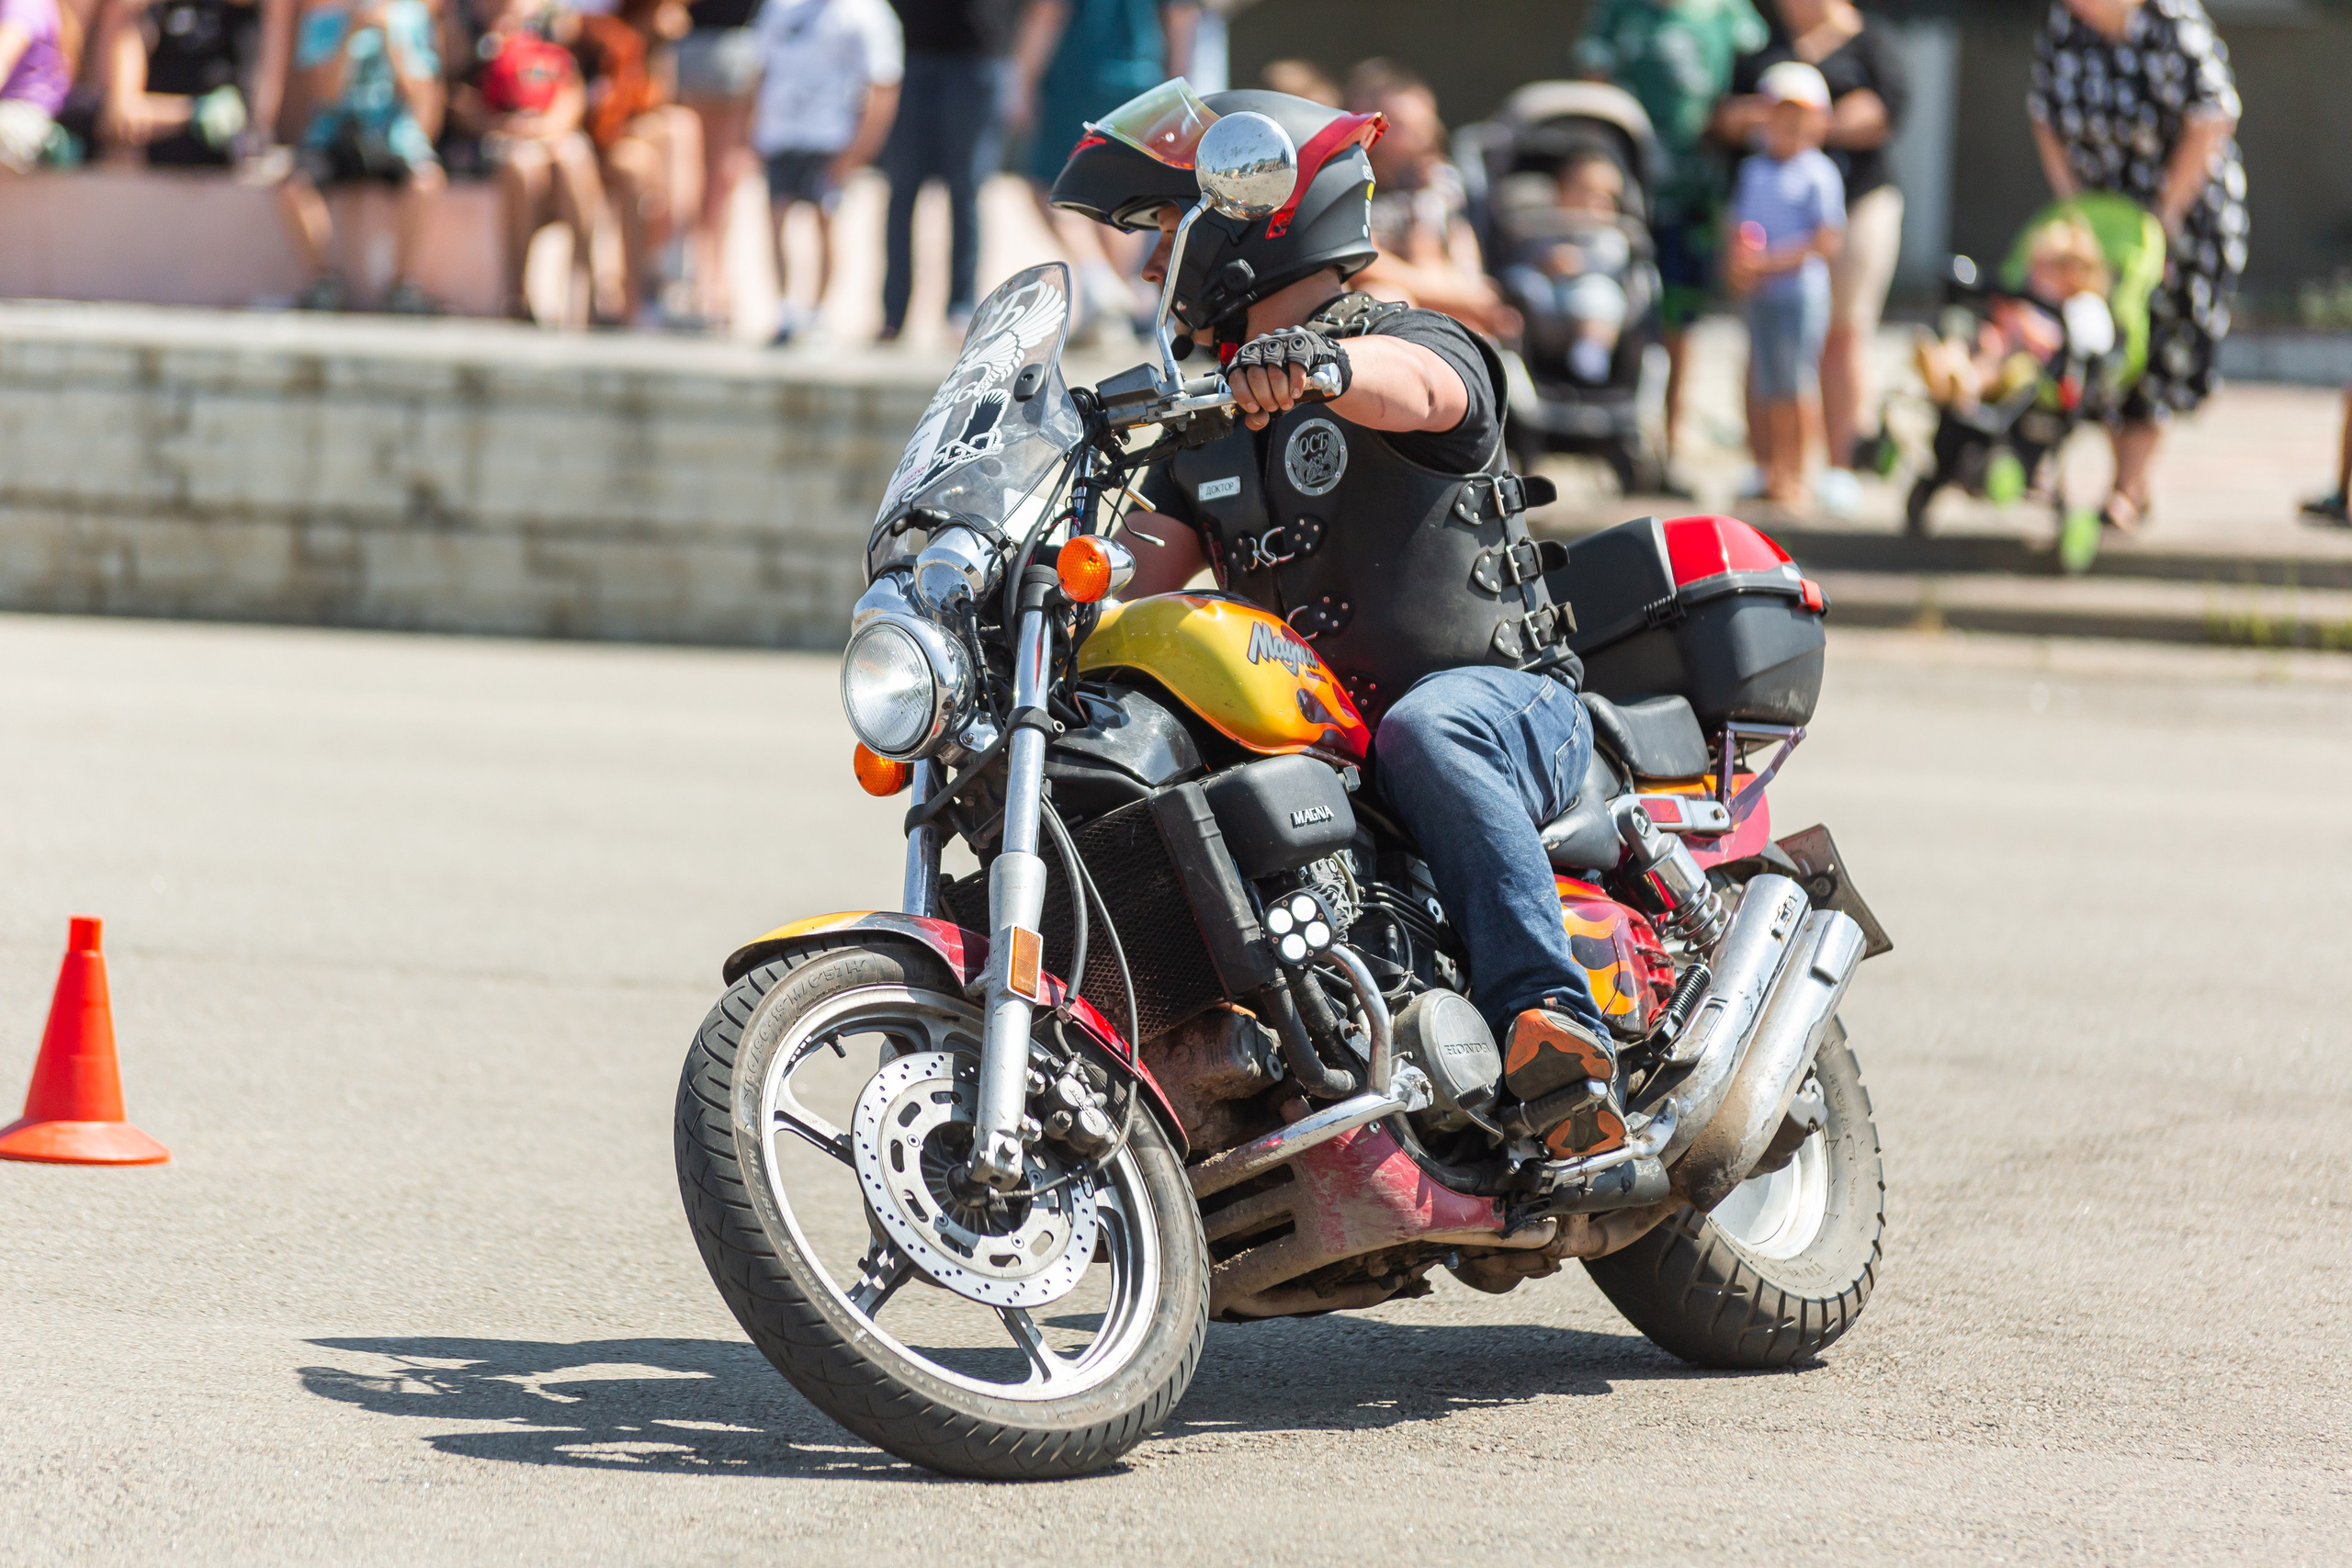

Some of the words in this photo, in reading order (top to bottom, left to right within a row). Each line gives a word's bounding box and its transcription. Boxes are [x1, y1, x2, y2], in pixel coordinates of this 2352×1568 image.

[1205, 481, 1235, 497] ДОКТОР
[1247, 620, 1319, 677] Magna
[1291, 805, 1335, 829] MAGNA
[1443, 1042, 1491, 1055] HONDA
